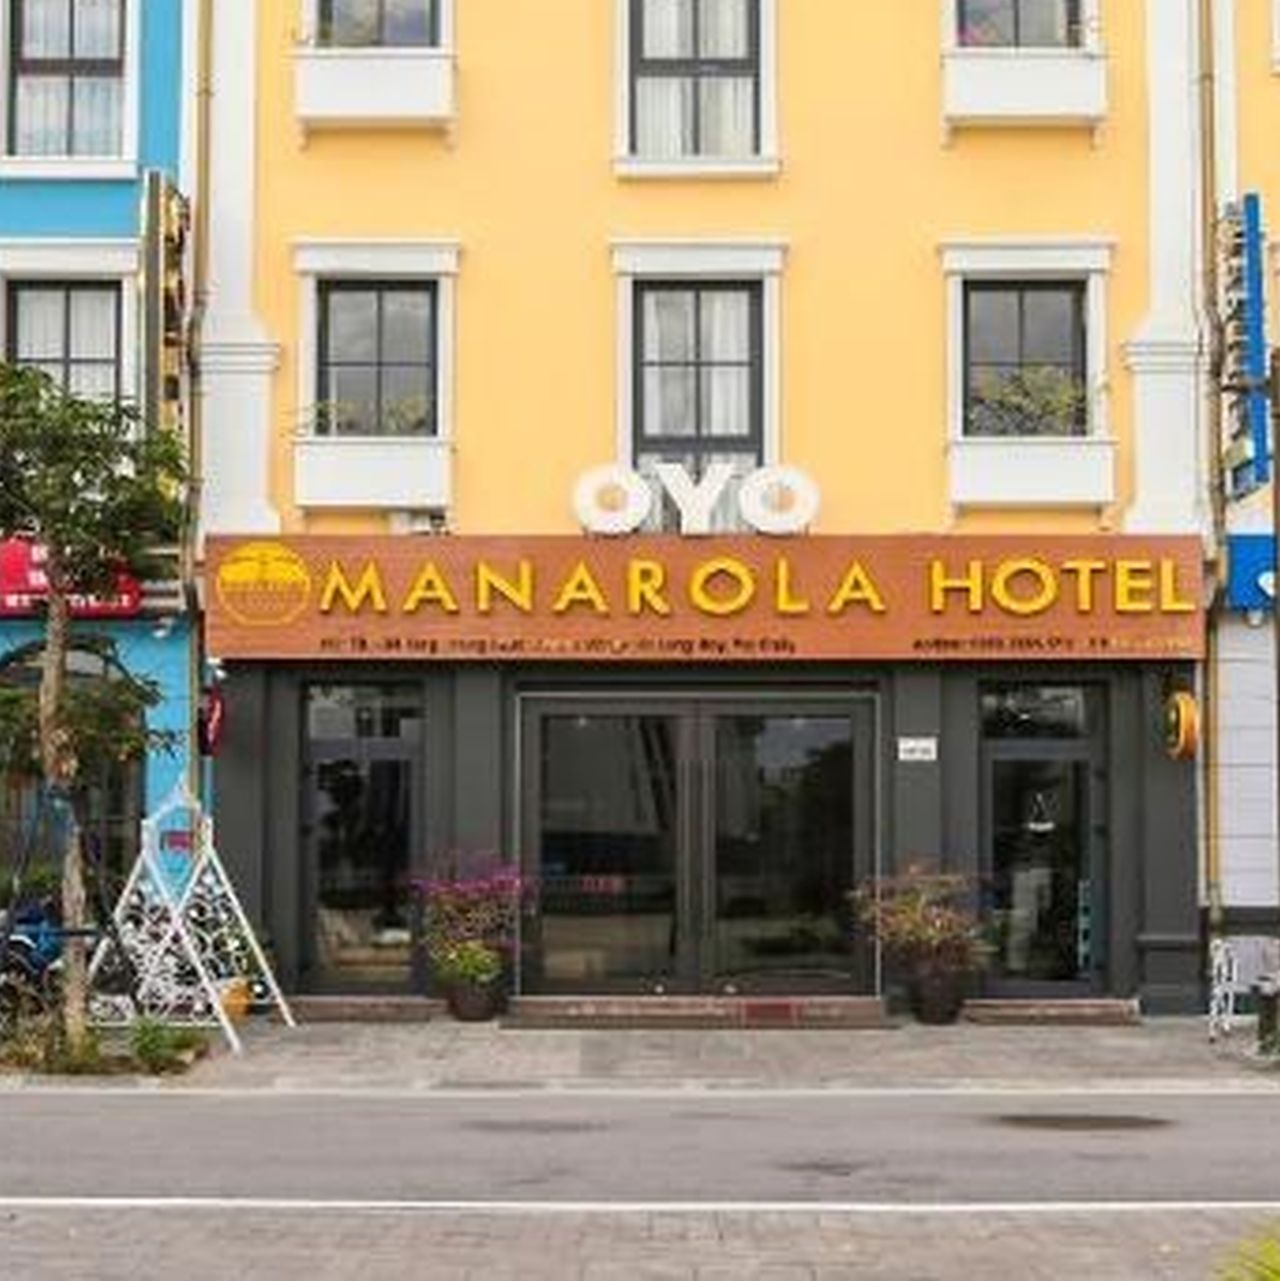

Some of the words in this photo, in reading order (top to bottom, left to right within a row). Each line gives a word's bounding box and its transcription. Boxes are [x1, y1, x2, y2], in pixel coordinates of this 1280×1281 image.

[573, 461, 819, 536] OYO
[320, 556, 887, 616] MANAROLA
[928, 557, 1197, 615] HOTEL
